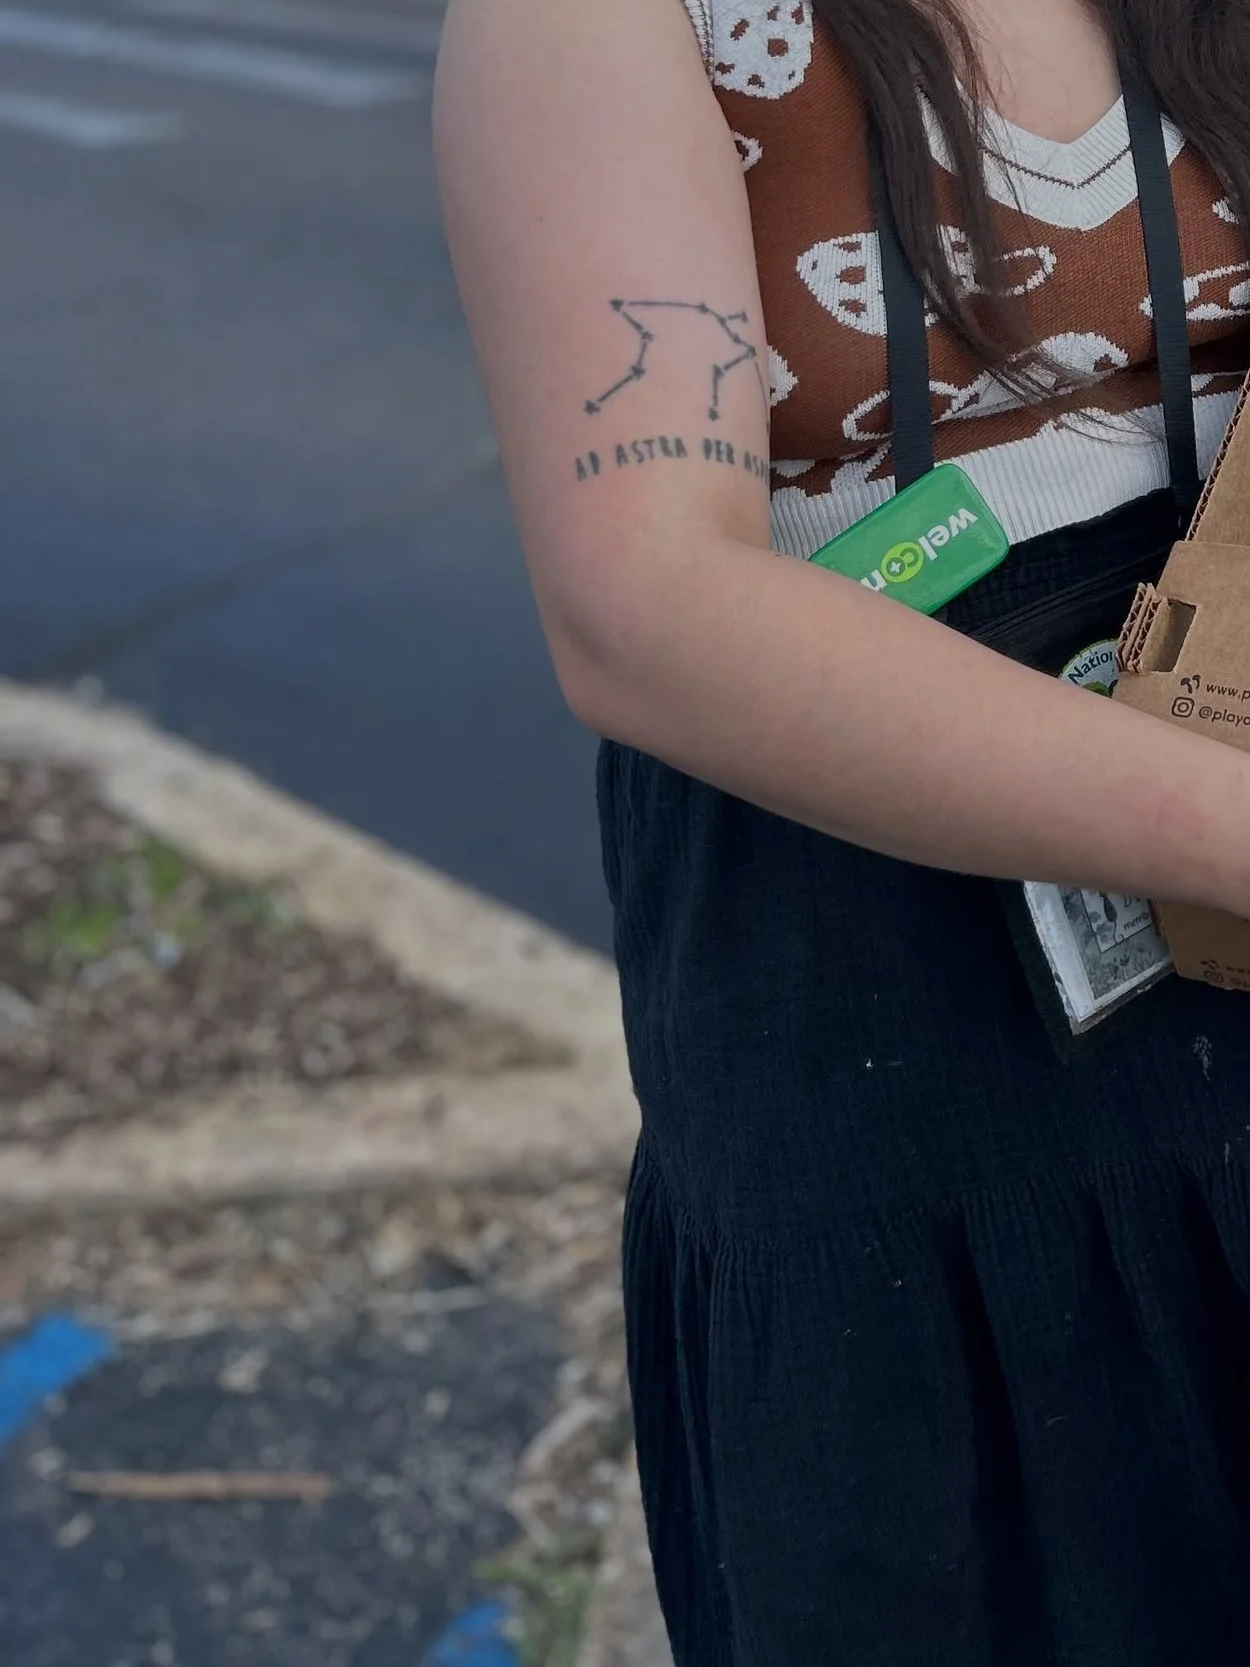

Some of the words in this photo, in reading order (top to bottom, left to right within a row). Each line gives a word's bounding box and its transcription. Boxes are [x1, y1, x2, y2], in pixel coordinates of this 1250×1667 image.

[575, 449, 601, 481] AD
[615, 435, 688, 468] ASTRA
[702, 437, 735, 465] PER
